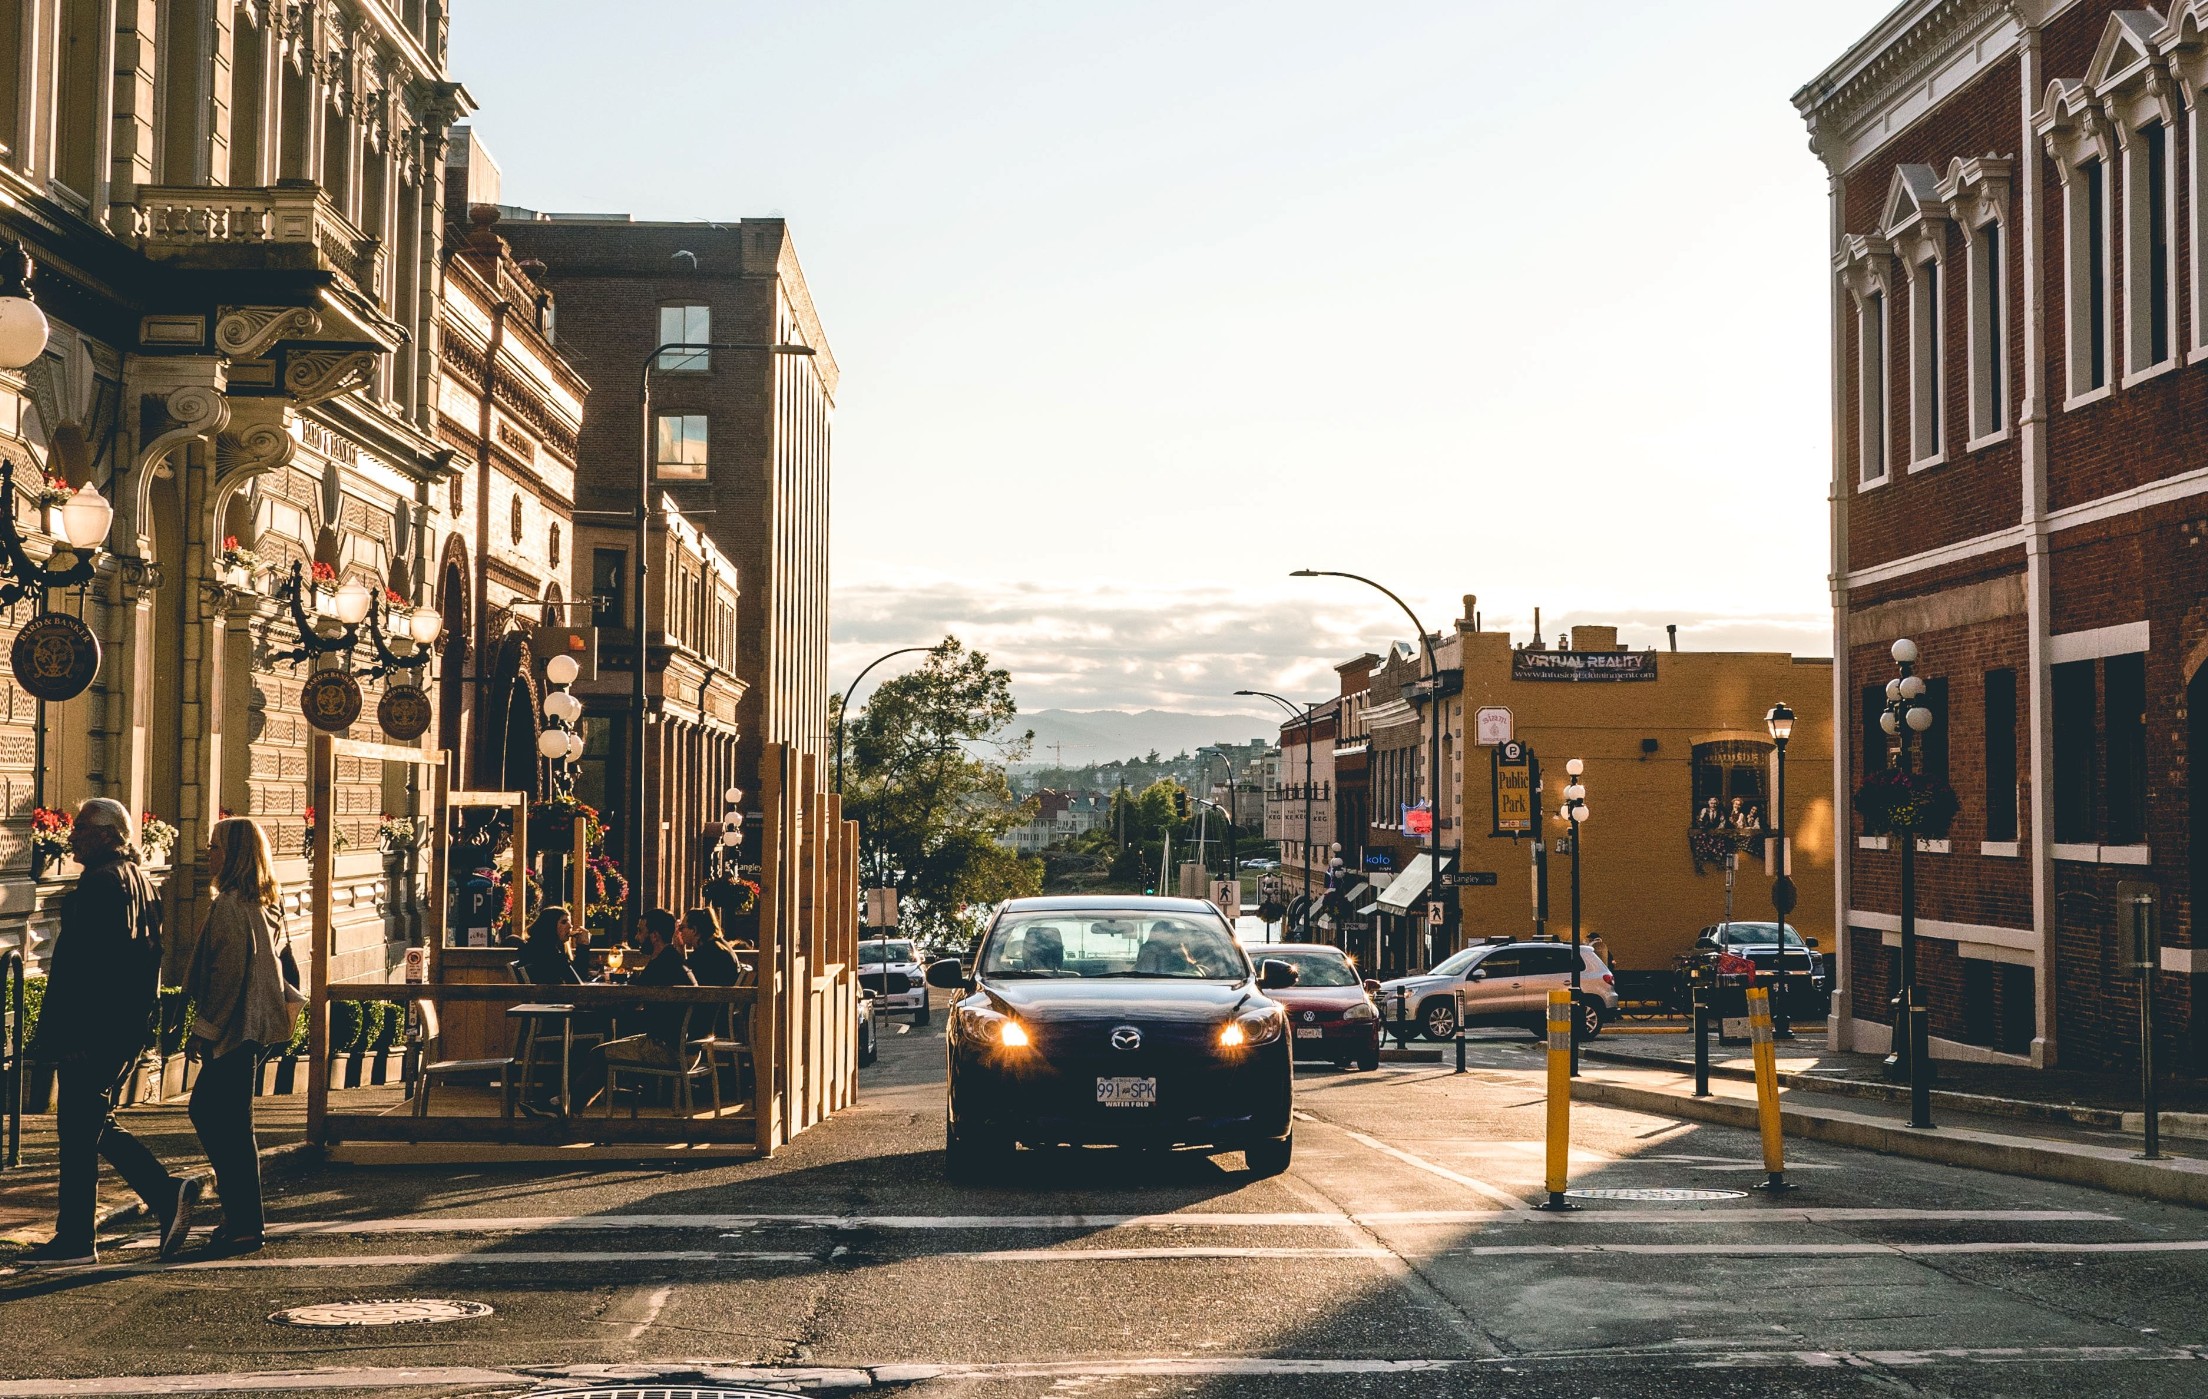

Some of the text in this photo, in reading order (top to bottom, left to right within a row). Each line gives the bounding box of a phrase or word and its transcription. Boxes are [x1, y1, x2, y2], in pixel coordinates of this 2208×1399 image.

[302, 418, 322, 450] BARD
[330, 433, 358, 468] BANKER
[19, 621, 43, 642] BARD
[53, 617, 91, 643] BANKER
[1525, 654, 1643, 668] VIRTUAL REALITY
[306, 673, 324, 690] BARD
[330, 672, 358, 690] BANKER
[1499, 771, 1529, 789] Public
[1502, 794, 1526, 813] Park
[1453, 874, 1480, 884] Langley
[473, 893, 484, 914] P
[1097, 1082, 1156, 1098] 991 SPK
